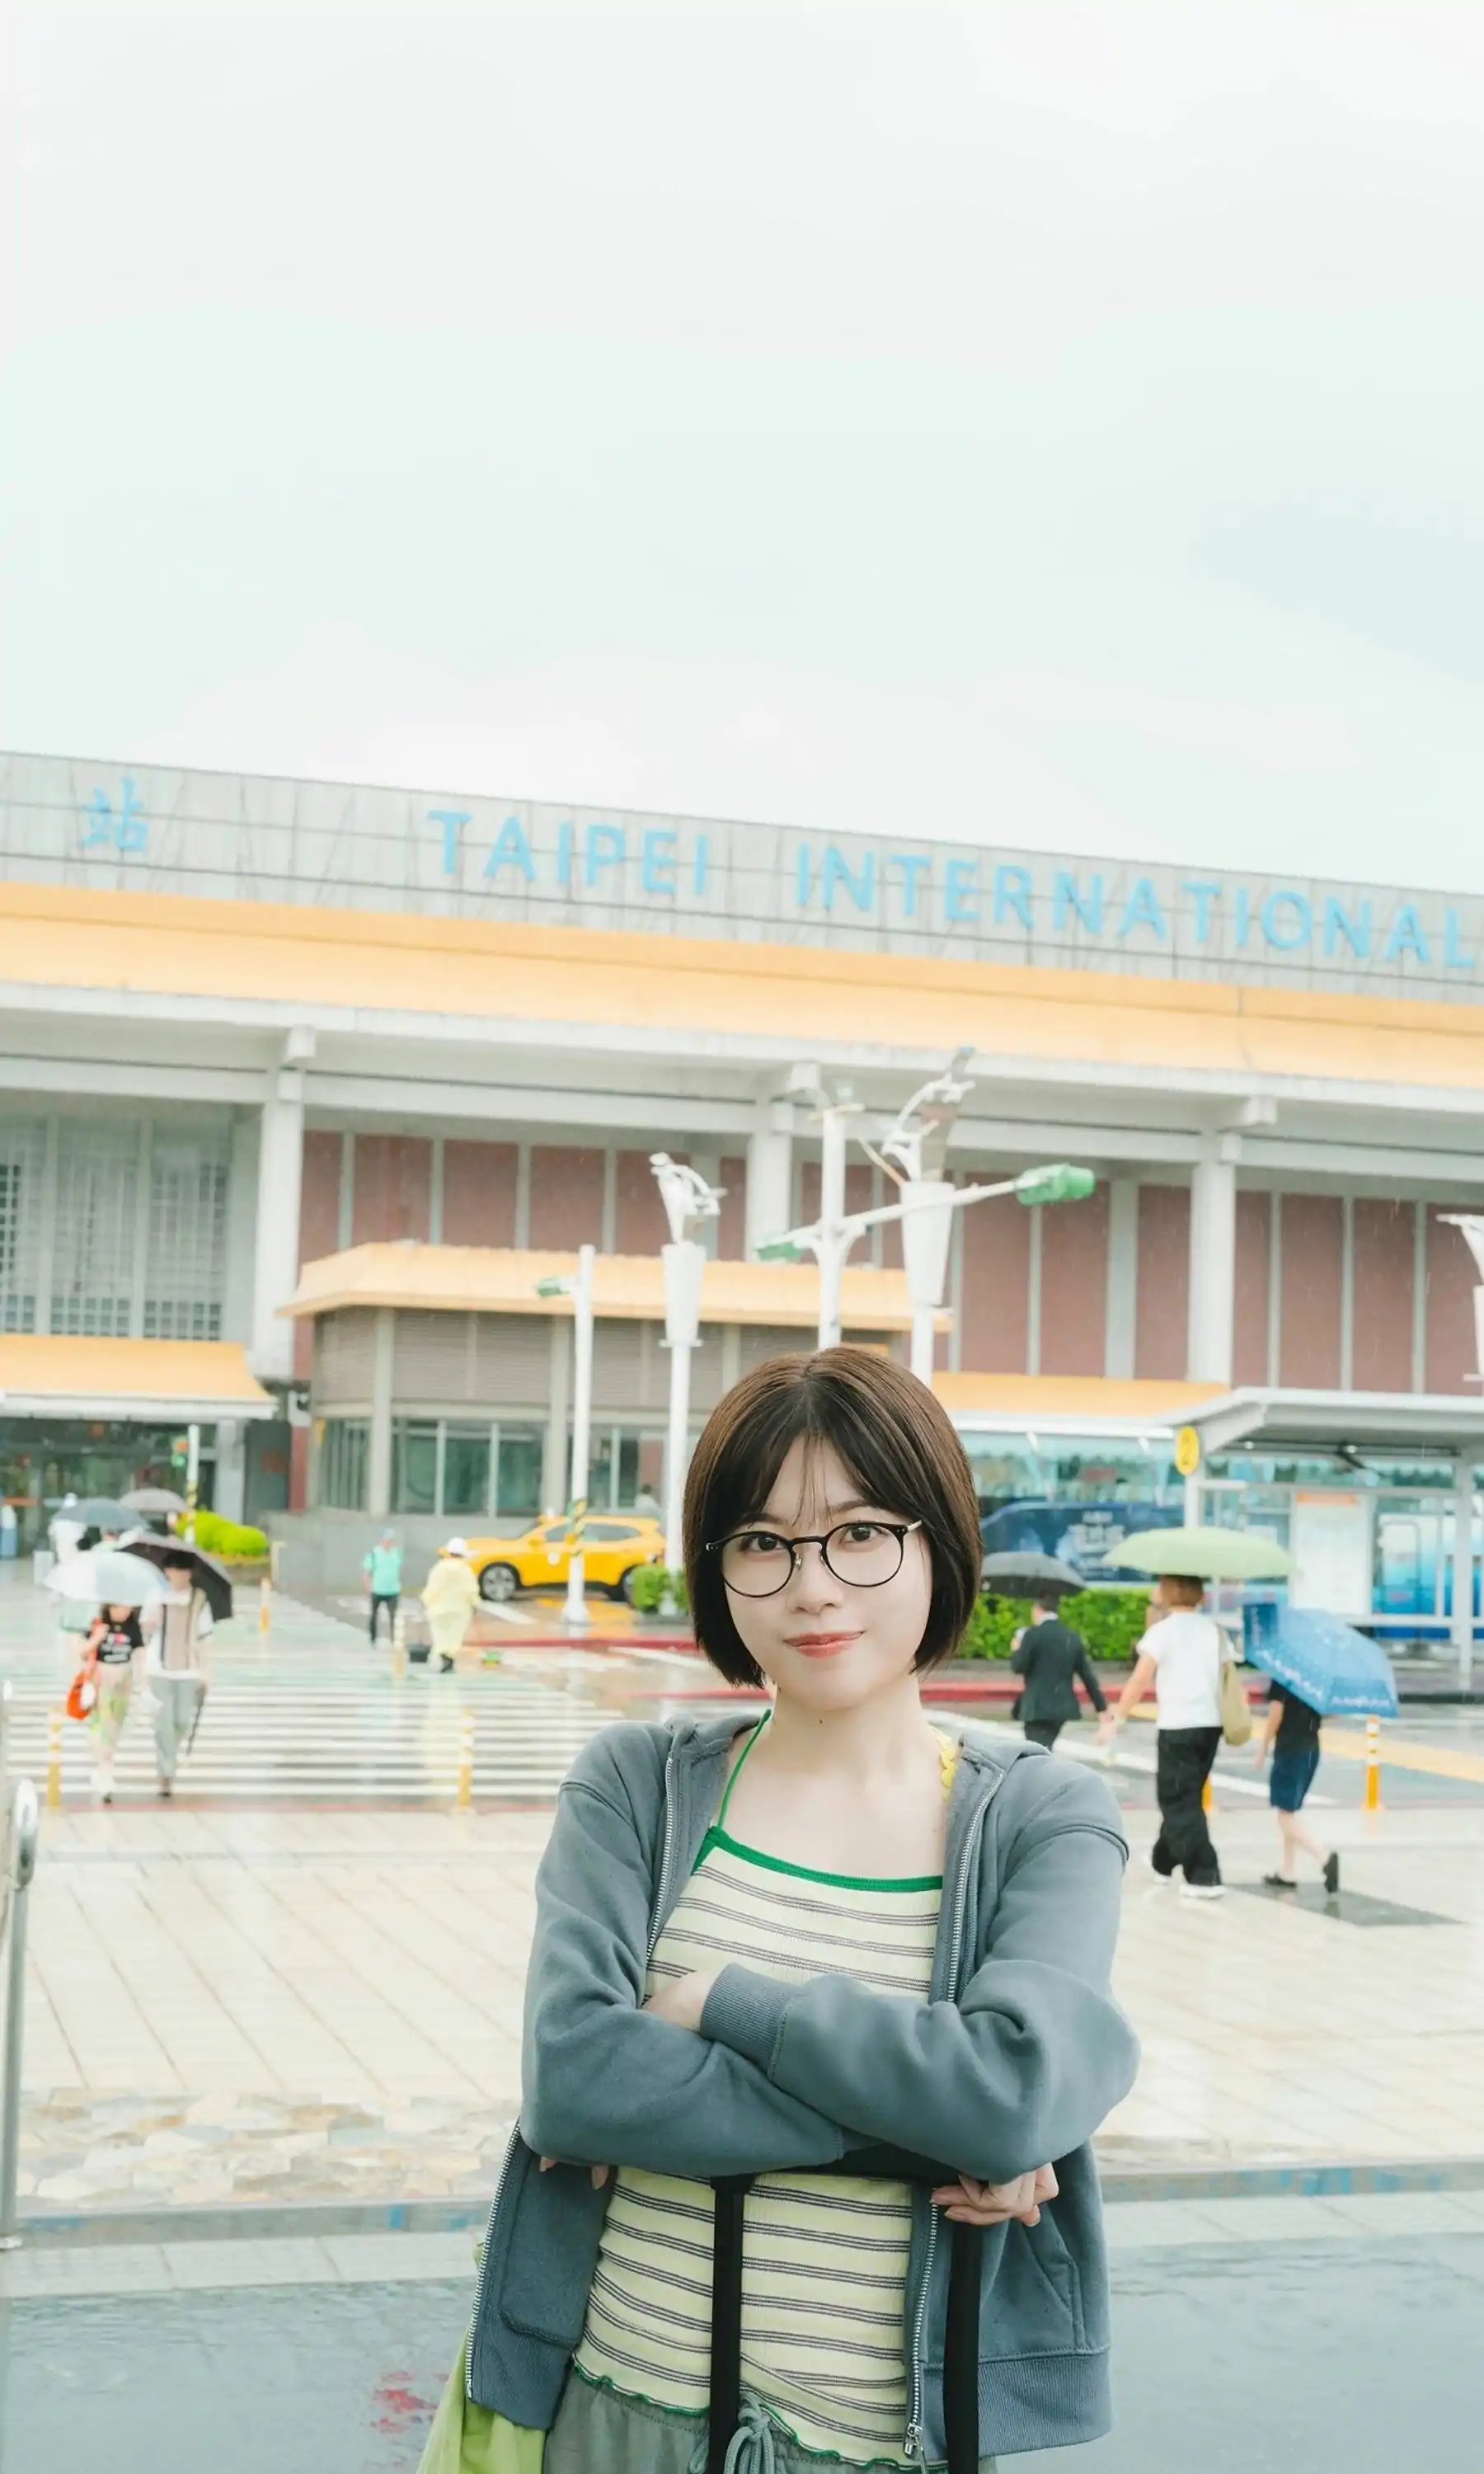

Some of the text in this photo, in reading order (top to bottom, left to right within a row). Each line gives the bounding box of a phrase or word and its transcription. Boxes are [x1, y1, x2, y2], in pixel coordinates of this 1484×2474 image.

[77, 776, 149, 852] 站
[427, 809, 1476, 969] TAIPEI INTERNATIONAL
